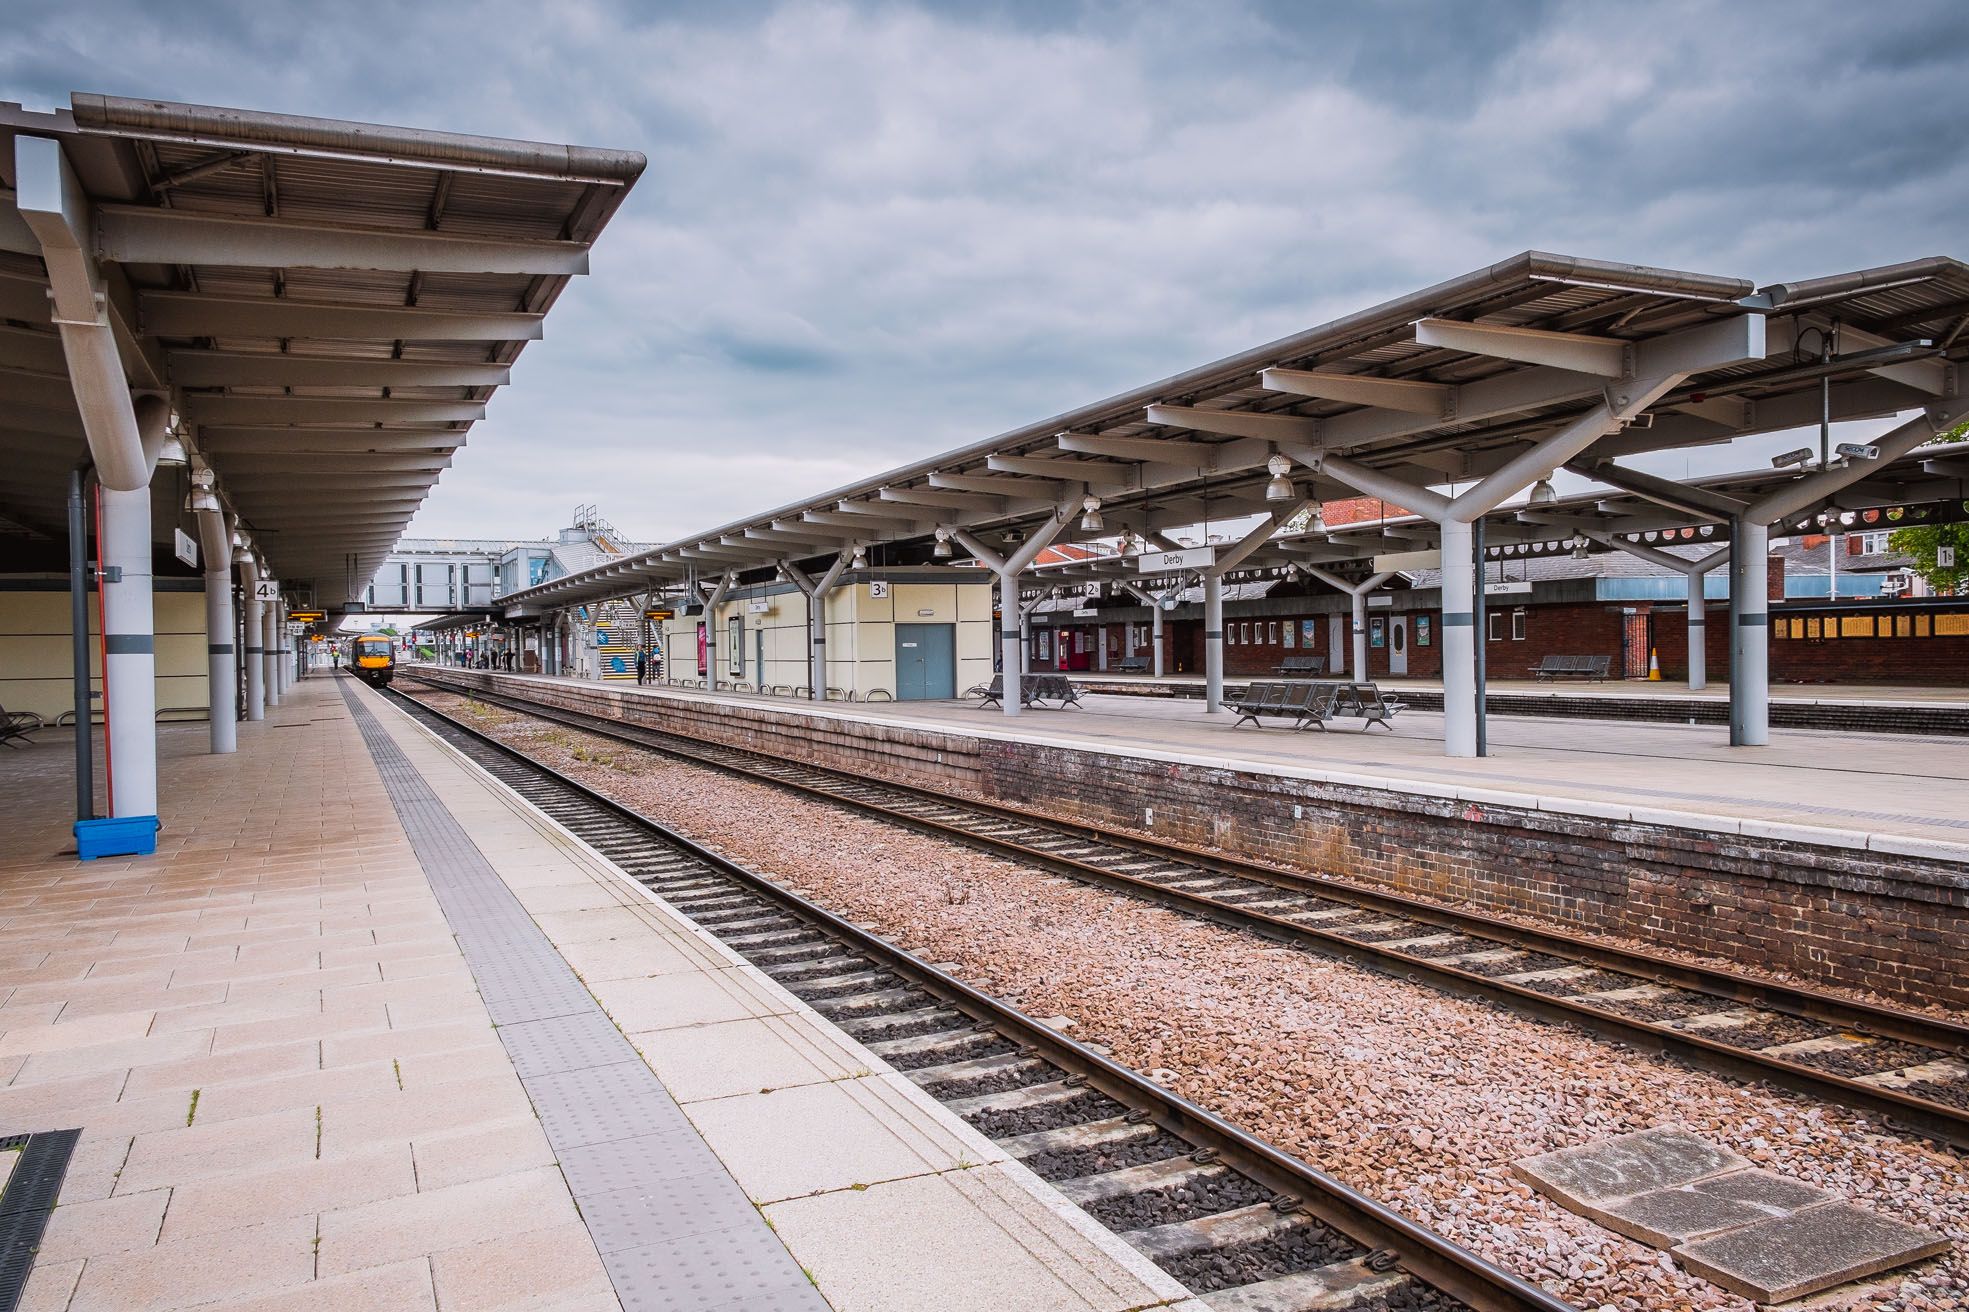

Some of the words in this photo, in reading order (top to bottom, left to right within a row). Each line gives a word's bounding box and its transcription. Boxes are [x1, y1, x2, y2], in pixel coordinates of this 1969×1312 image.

[1163, 555, 1184, 566] Derby
[257, 584, 276, 597] 4b
[873, 583, 887, 596] 3b
